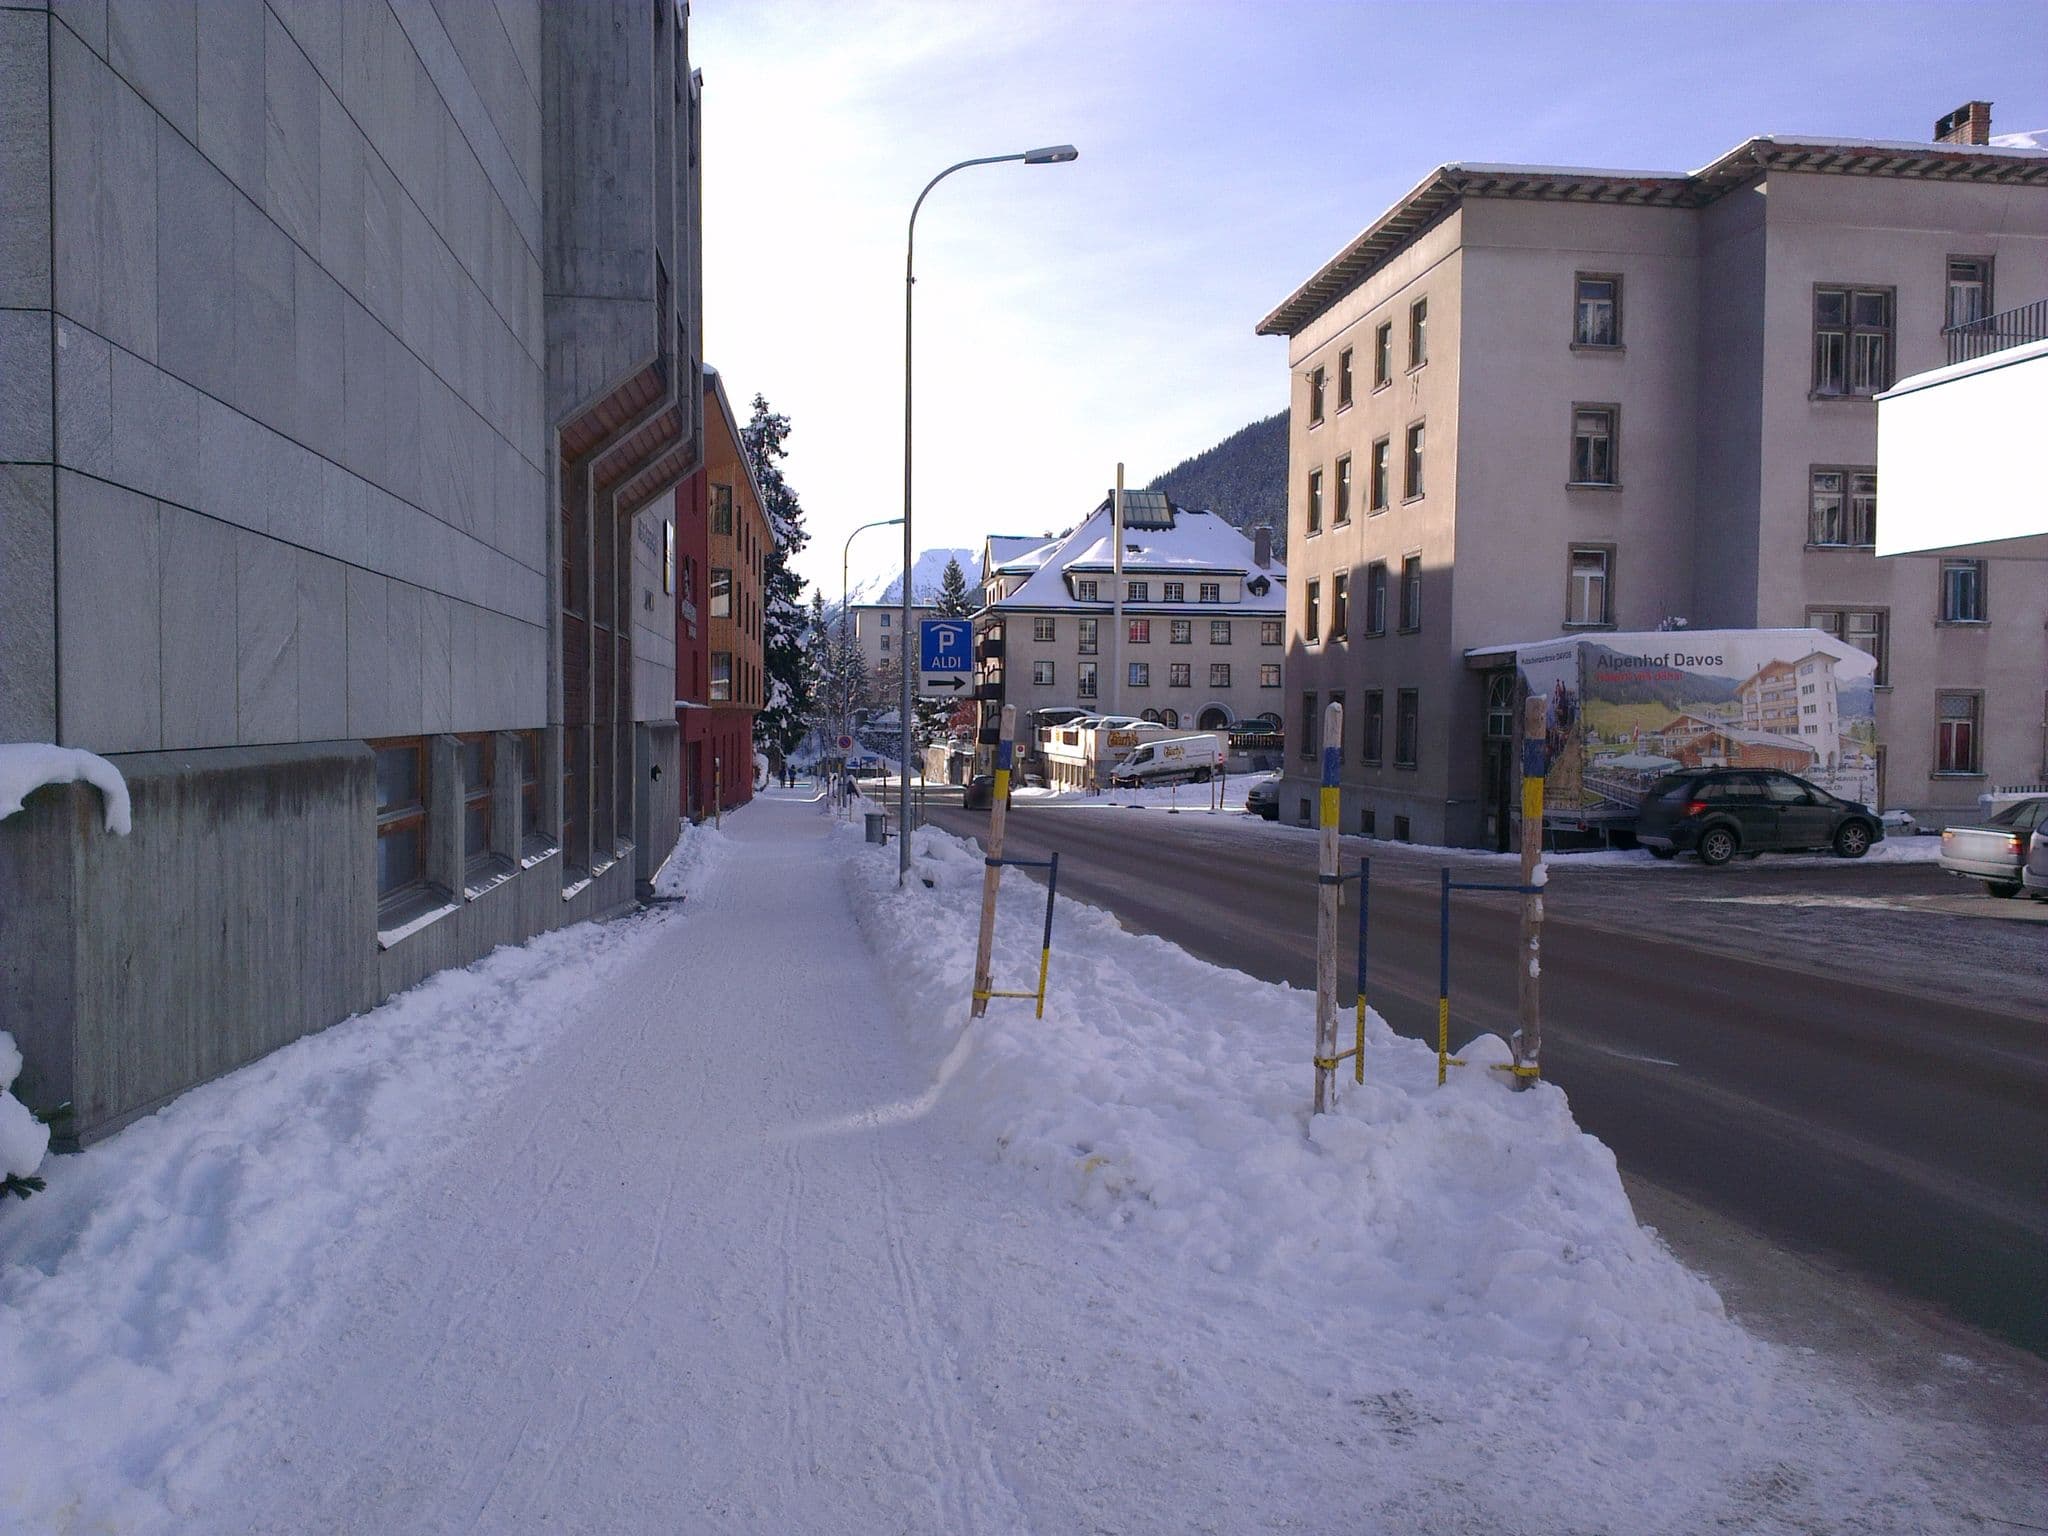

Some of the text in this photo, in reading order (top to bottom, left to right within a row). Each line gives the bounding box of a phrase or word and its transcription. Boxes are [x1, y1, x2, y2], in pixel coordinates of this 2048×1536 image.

[939, 631, 954, 654] P
[931, 656, 961, 668] ALDI
[1597, 653, 1723, 670] Alpenhof Davos
